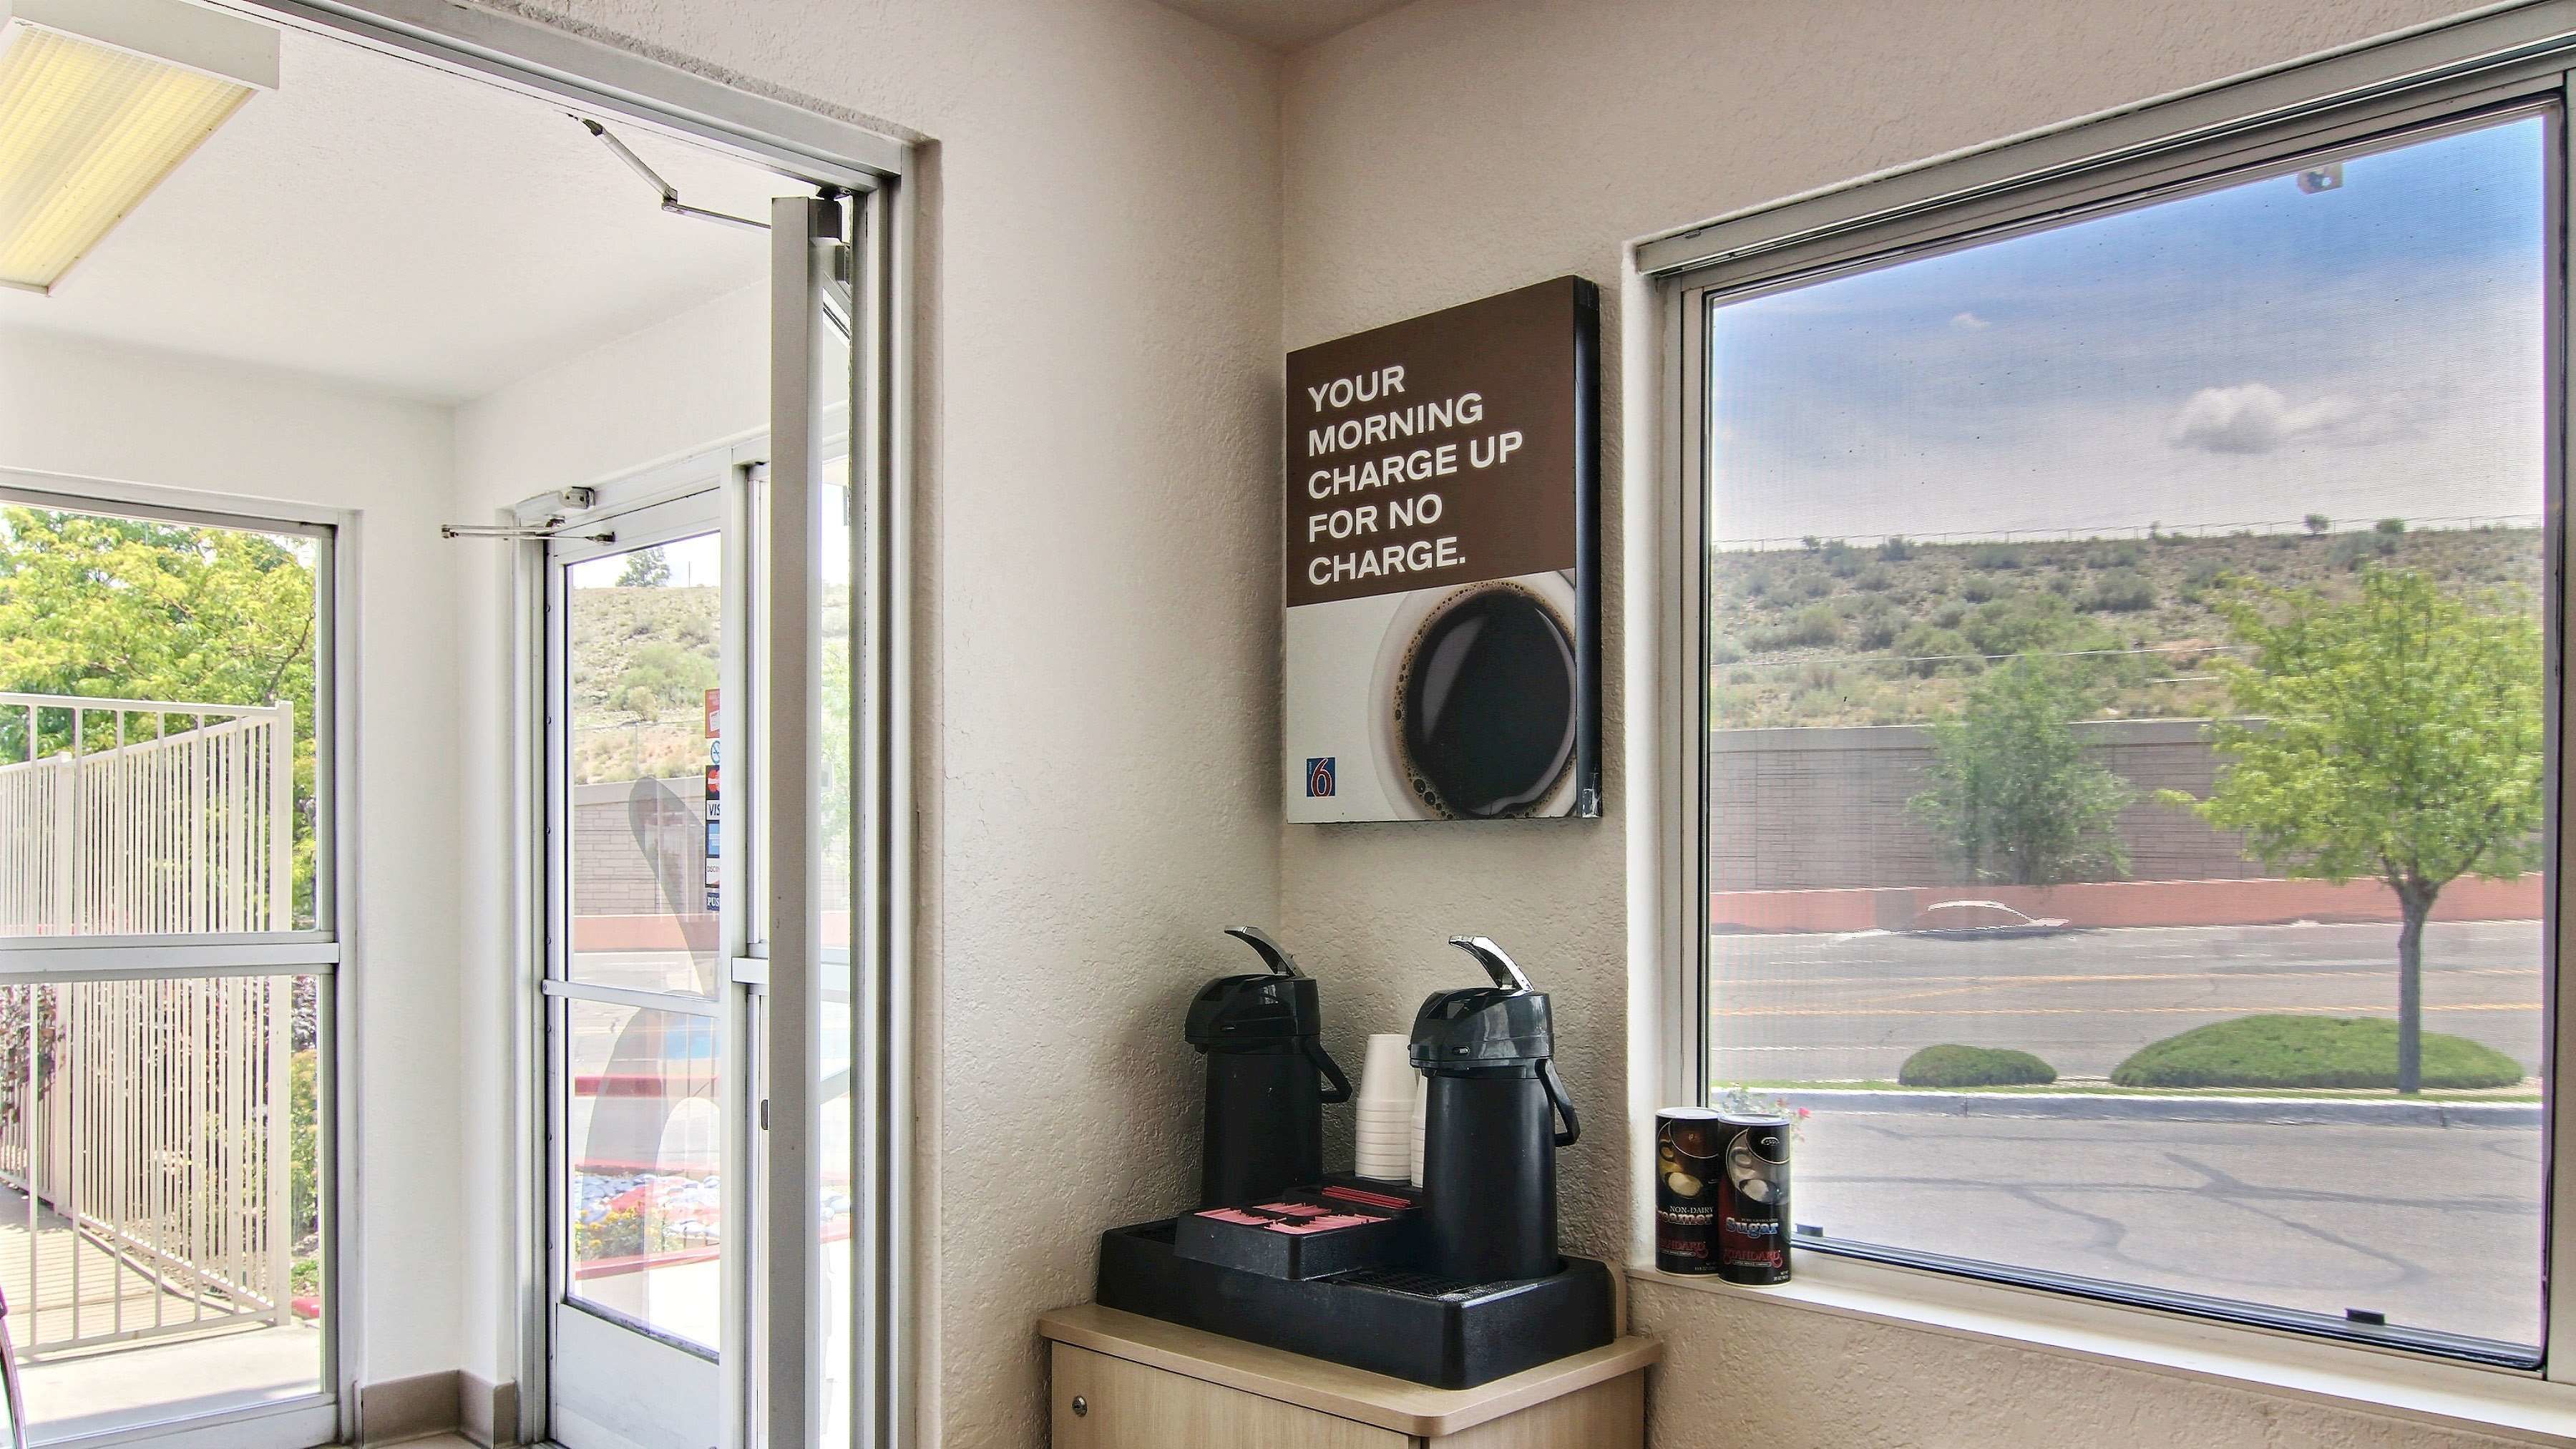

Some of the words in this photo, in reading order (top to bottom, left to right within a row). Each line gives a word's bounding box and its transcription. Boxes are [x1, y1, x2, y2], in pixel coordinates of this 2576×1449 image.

[1308, 365, 1405, 412] YOUR
[1309, 392, 1483, 457] MORNING
[1308, 444, 1458, 499] CHARGE
[1470, 431, 1523, 469] UP
[1309, 505, 1378, 542] FOR
[1389, 494, 1443, 530] NO
[1308, 536, 1465, 585] CHARGE.
[1311, 758, 1332, 798] 6
[1669, 1205, 1714, 1214] NON-DAIRY
[1726, 1217, 1779, 1239] Sugar
